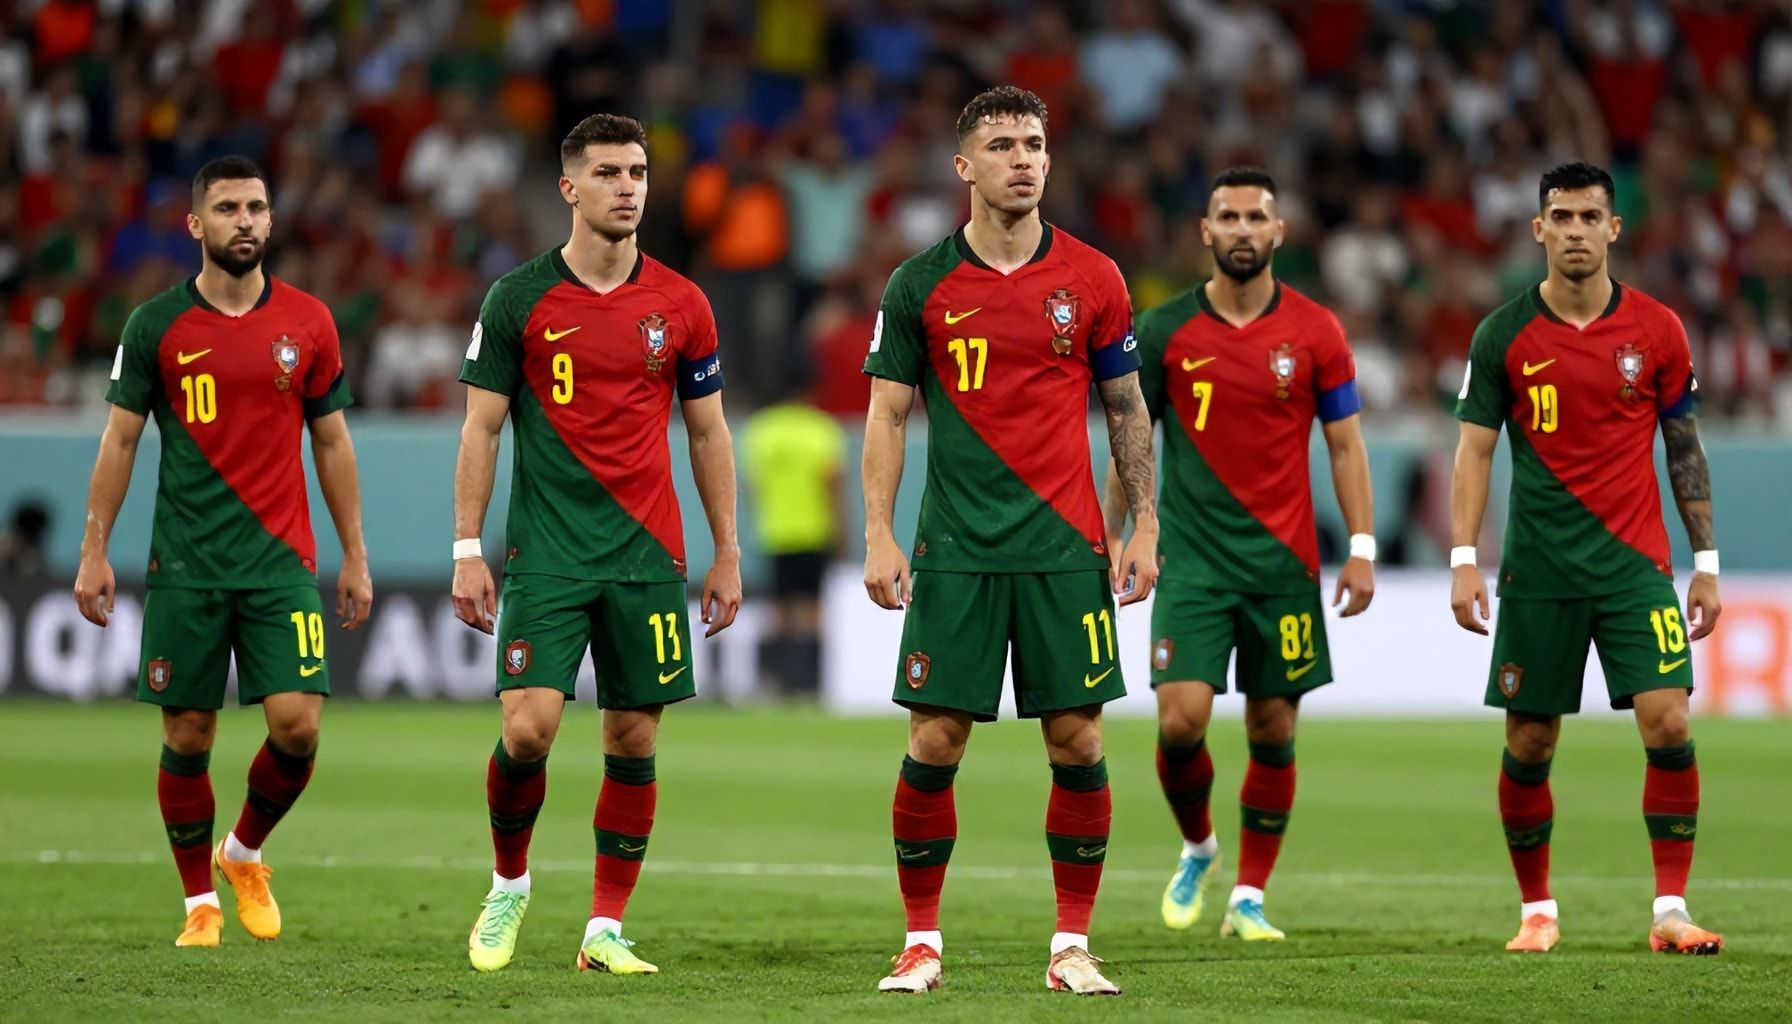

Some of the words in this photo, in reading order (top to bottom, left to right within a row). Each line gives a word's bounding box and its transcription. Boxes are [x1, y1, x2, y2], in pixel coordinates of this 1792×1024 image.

[552, 353, 573, 404] 9
[947, 338, 987, 391] 17
[181, 374, 216, 423] 10
[1193, 381, 1213, 430] 7
[1528, 385, 1557, 433] 19
